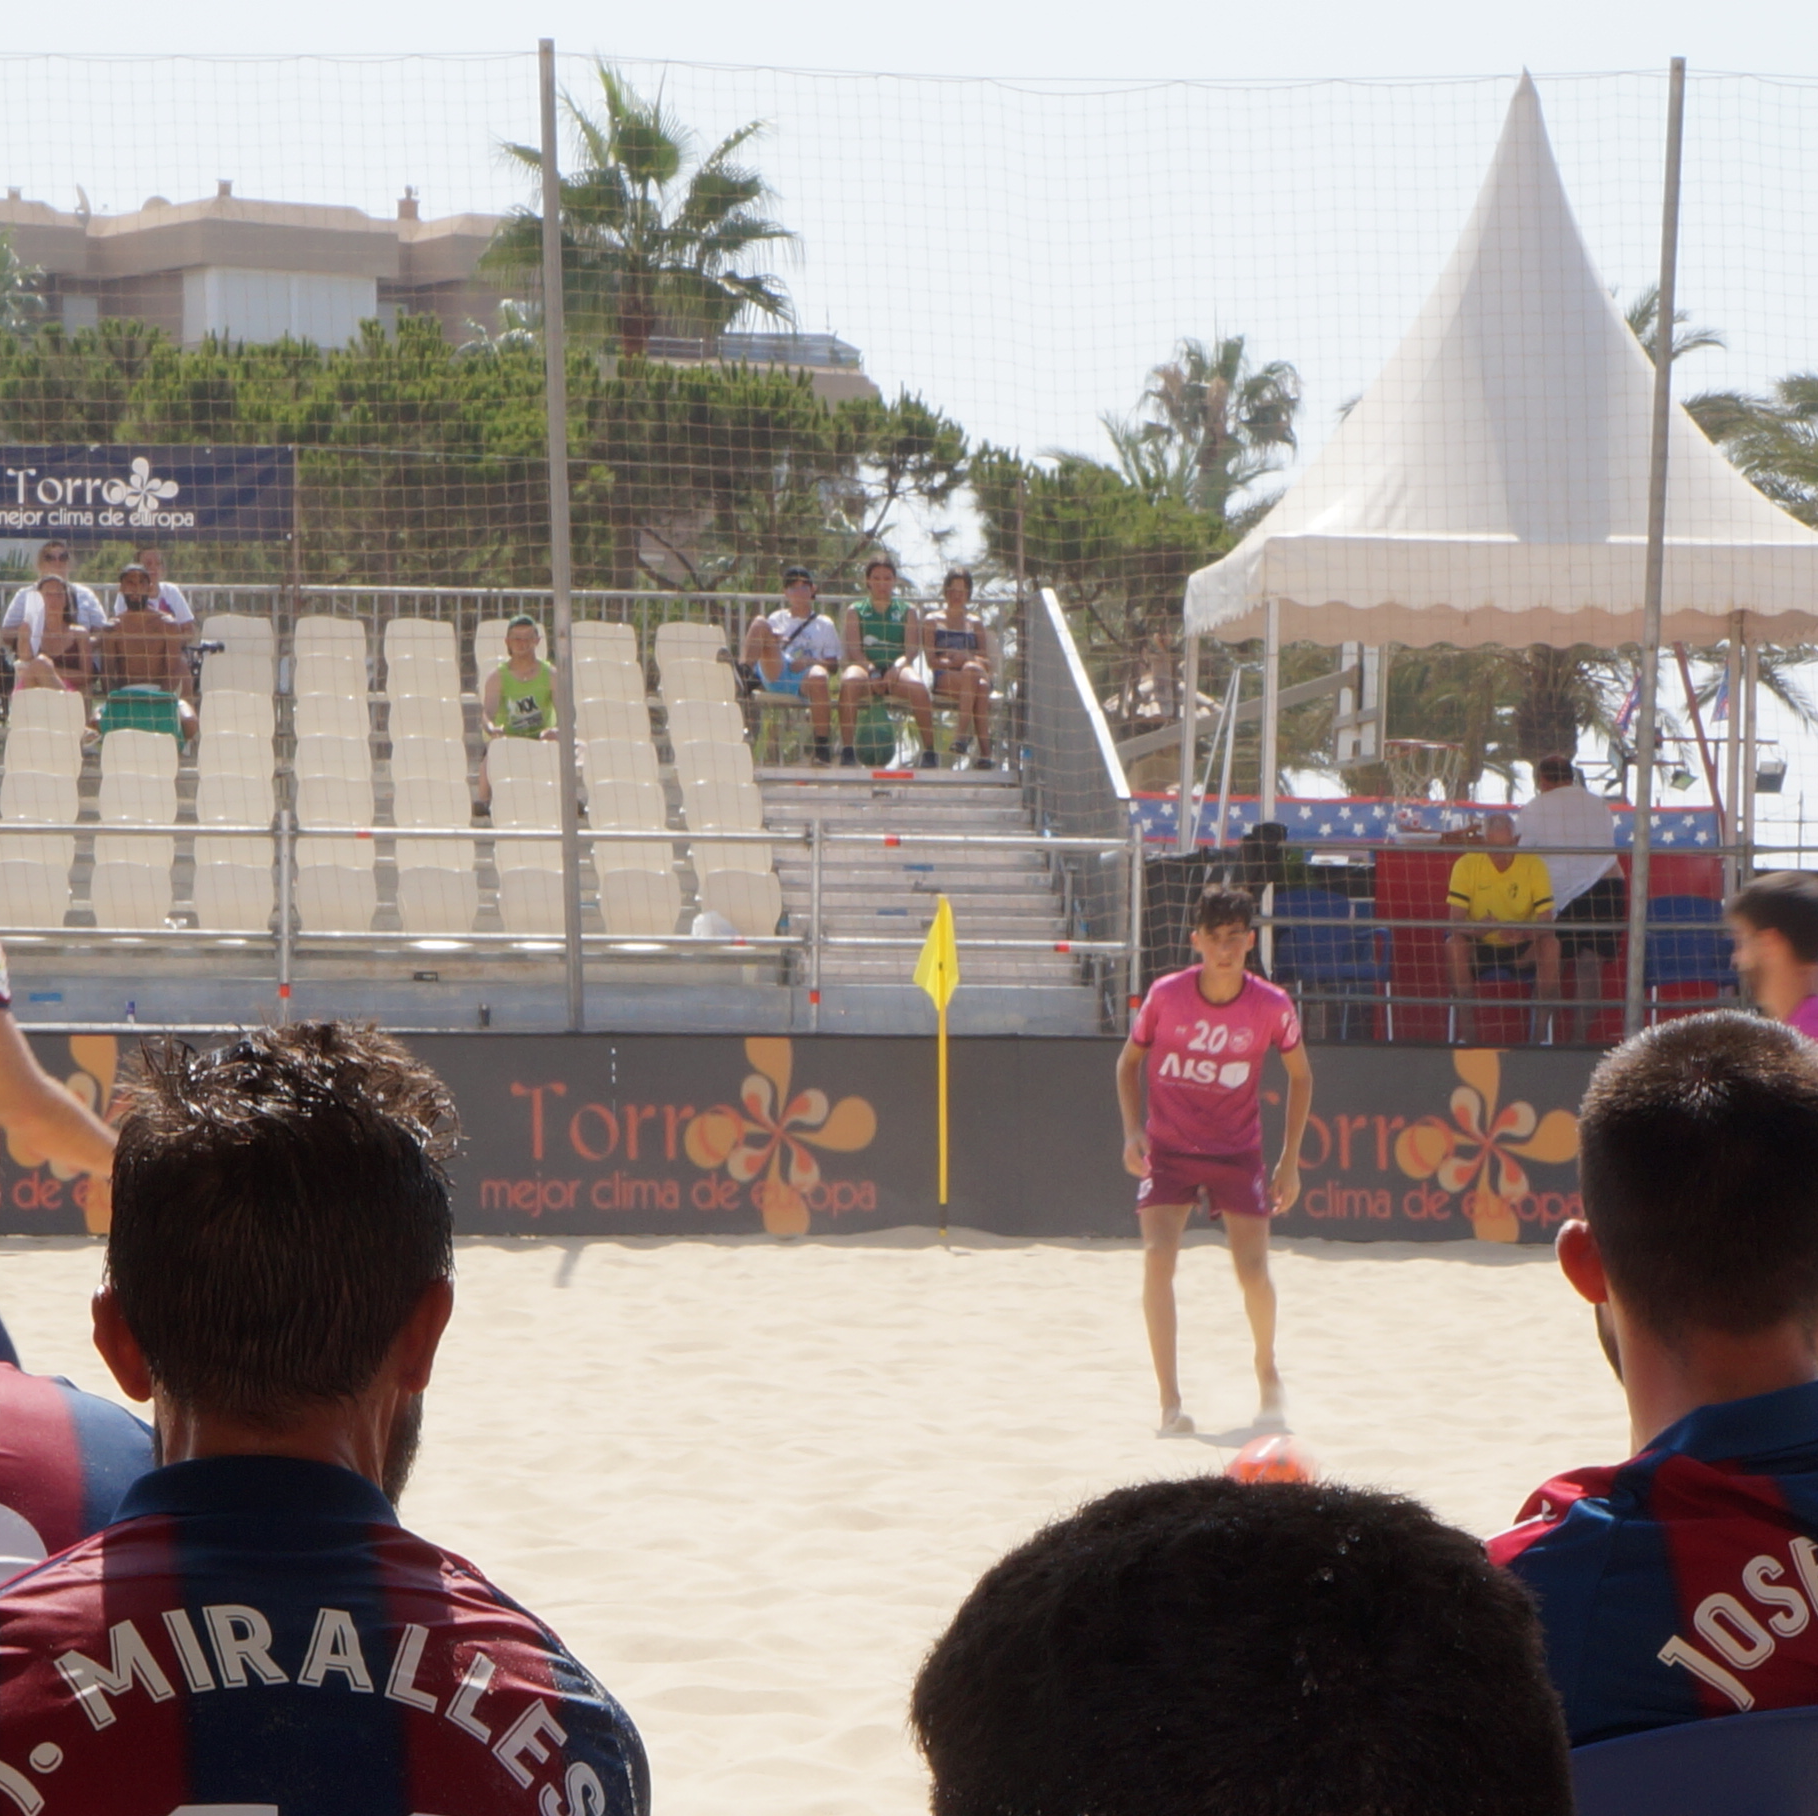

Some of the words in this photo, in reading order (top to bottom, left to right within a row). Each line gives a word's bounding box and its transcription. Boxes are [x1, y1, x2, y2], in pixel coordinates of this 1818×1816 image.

[48, 507, 93, 527] clima
[98, 508, 124, 527] de
[129, 511, 195, 531] europa
[1187, 1019, 1229, 1054] 20
[12, 1170, 62, 1210] de
[481, 1172, 581, 1218] mejor
[591, 1171, 679, 1211] clima
[691, 1172, 740, 1212] de
[1305, 1180, 1391, 1219] clima
[1403, 1181, 1451, 1220] de
